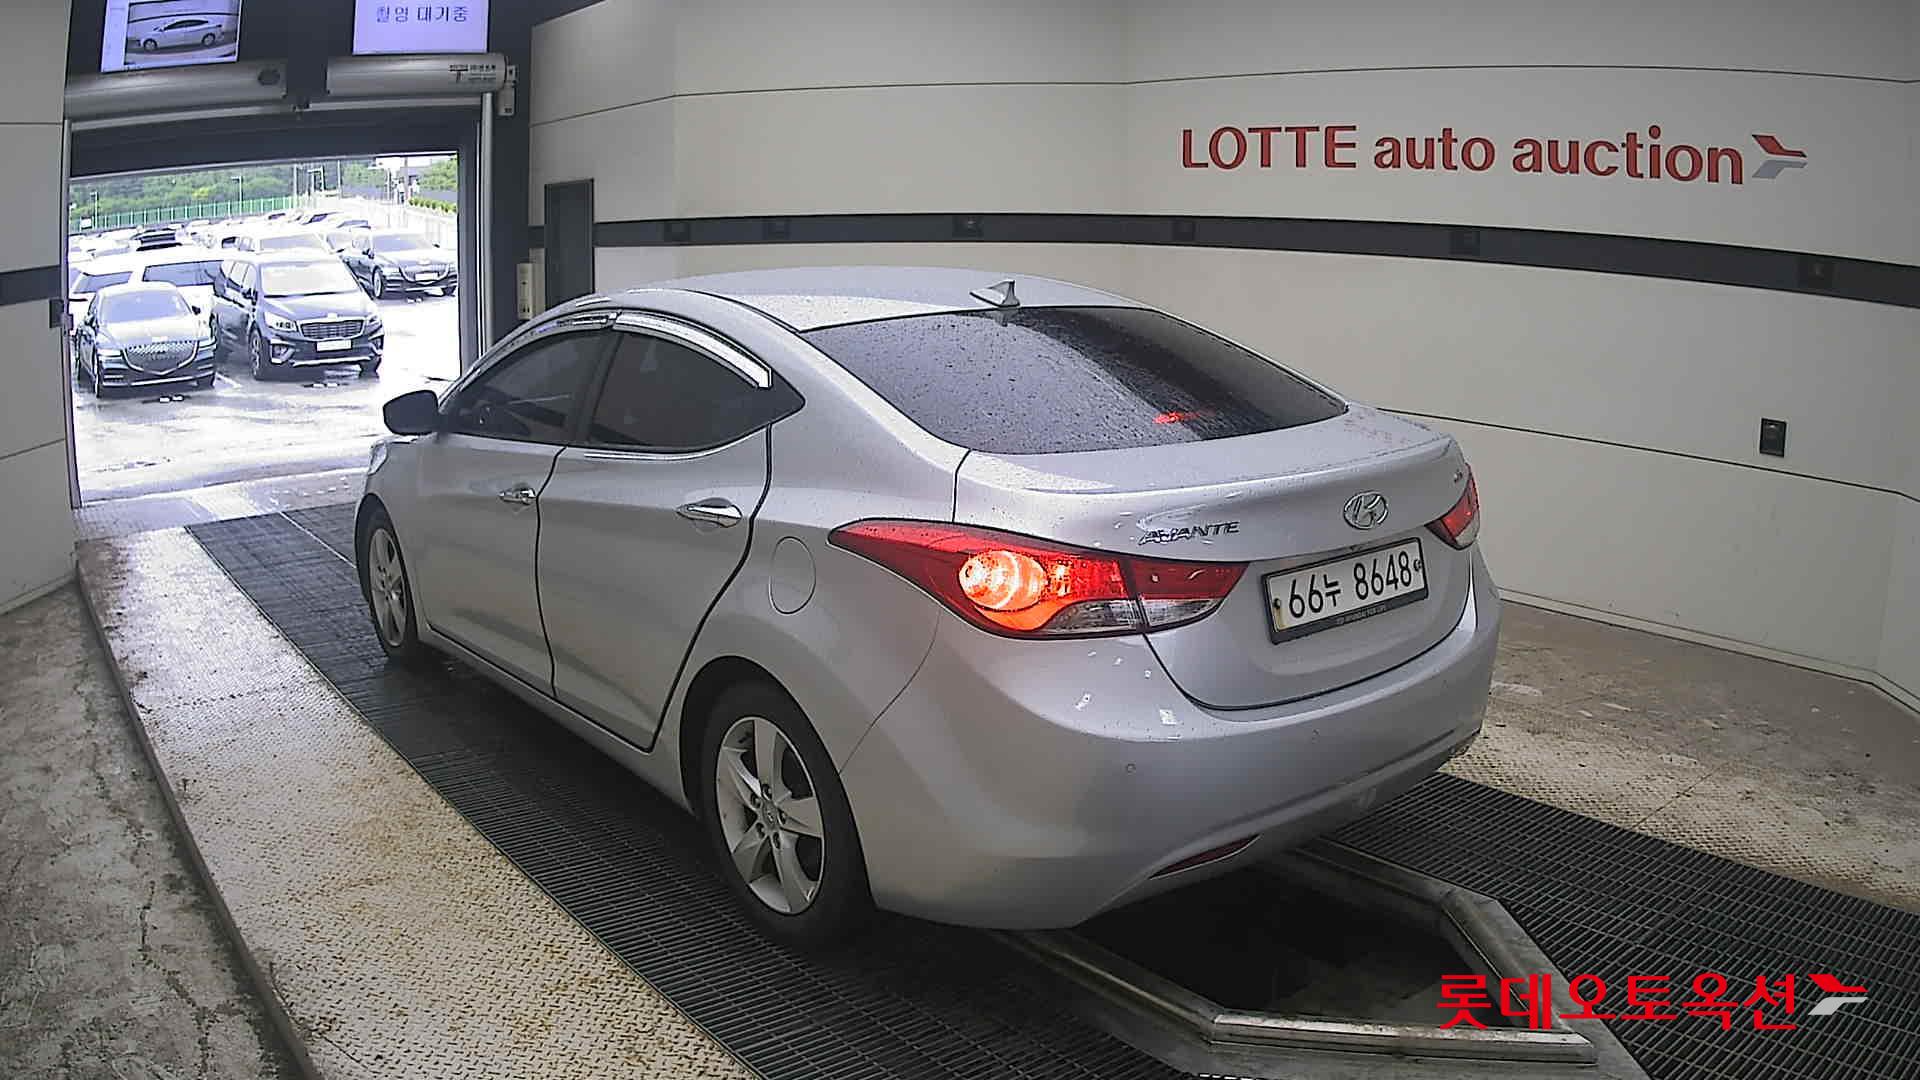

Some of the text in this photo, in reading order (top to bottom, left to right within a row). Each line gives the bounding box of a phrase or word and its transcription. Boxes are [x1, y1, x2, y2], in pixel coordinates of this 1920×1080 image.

[417, 4, 467, 23] 대기중
[1181, 124, 1744, 185] LOTTE auto auction
[1138, 521, 1240, 546] AVANTE
[1288, 573, 1342, 618] 66누
[1353, 550, 1412, 600] 8648
